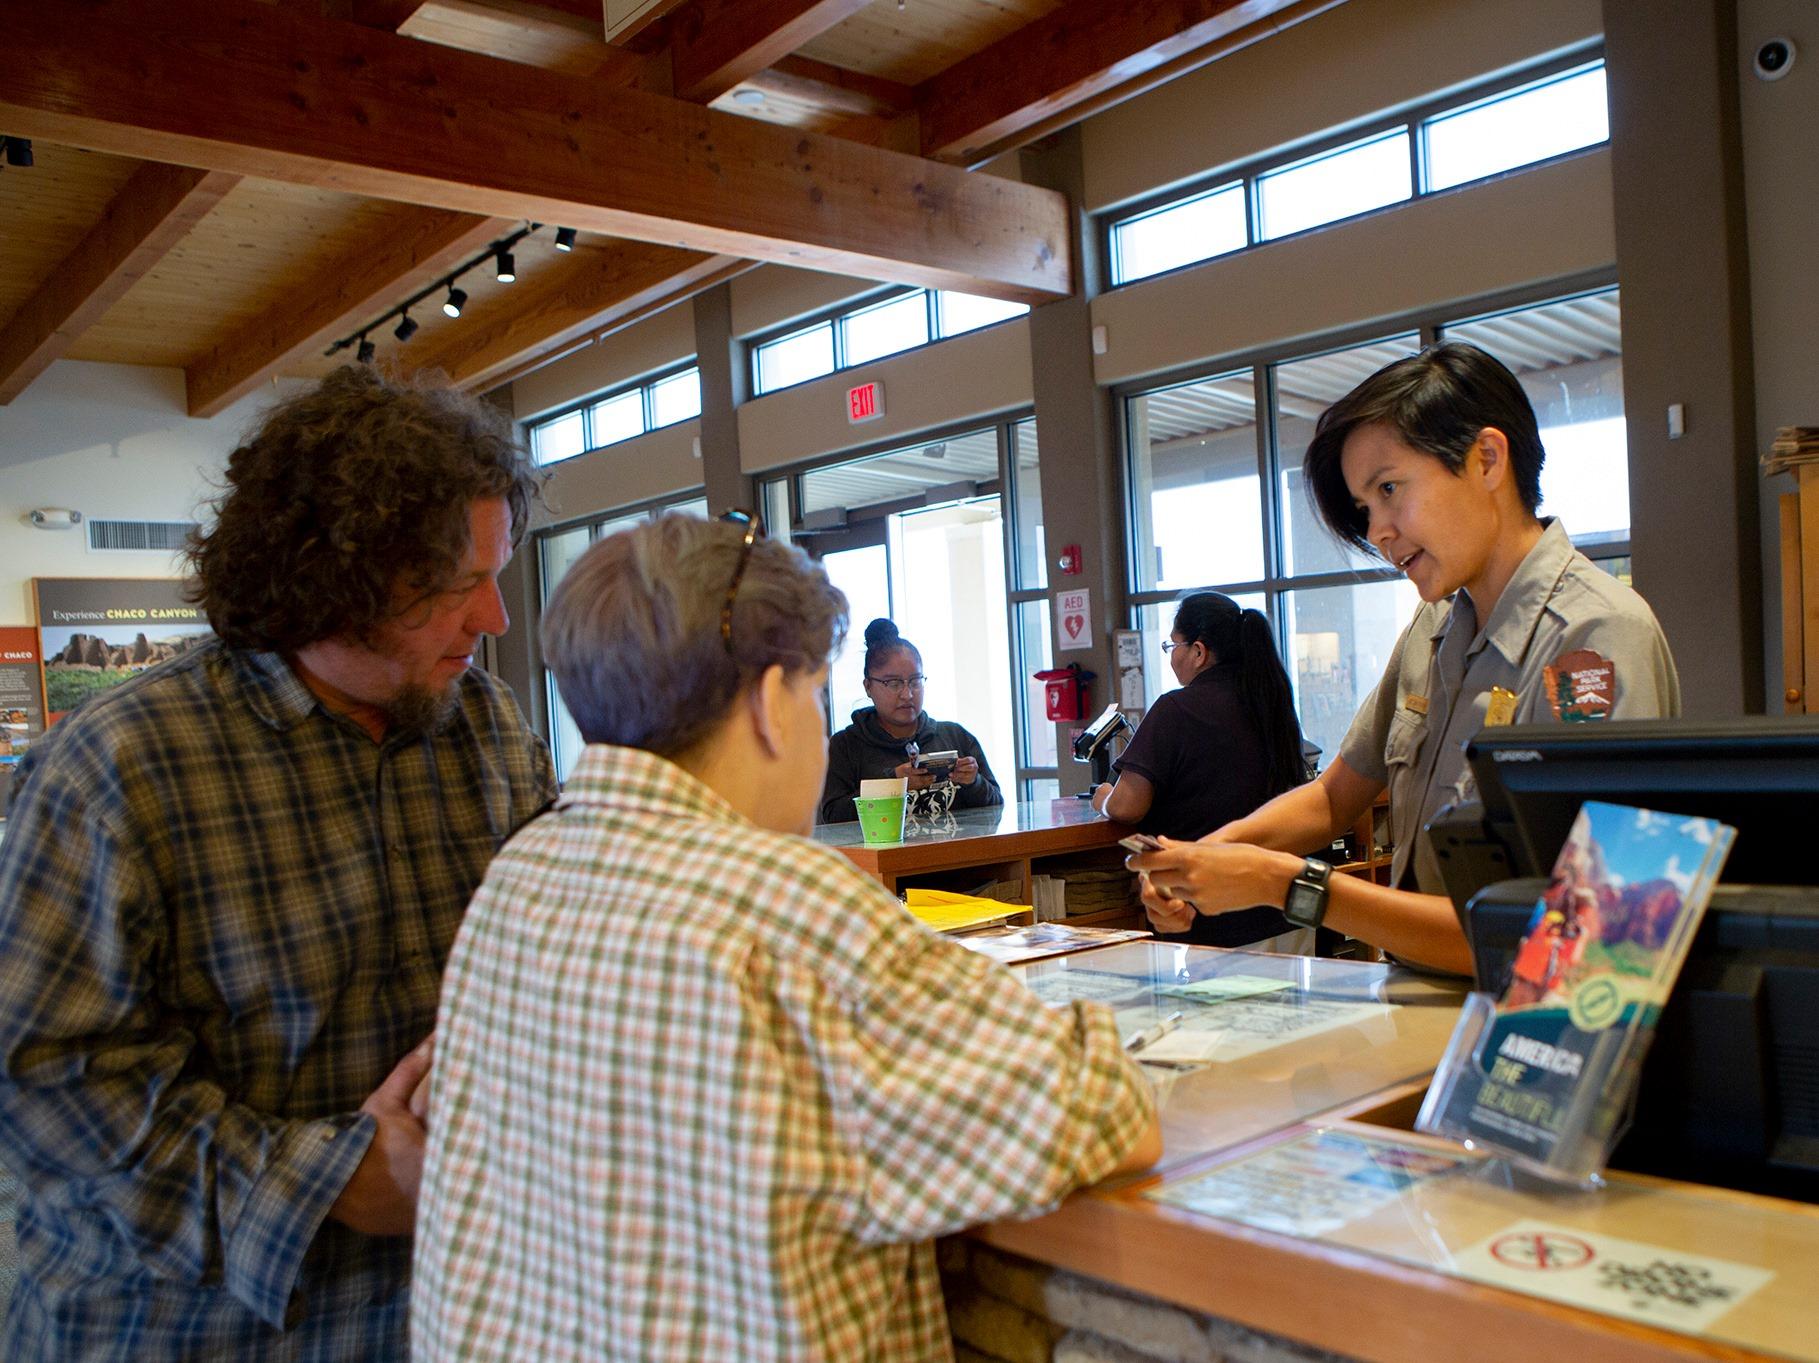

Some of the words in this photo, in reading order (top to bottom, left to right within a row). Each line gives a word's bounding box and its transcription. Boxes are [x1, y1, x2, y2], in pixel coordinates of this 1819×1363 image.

[851, 384, 874, 419] EXIT
[1064, 596, 1083, 609] AED
[53, 609, 105, 622] Experience
[106, 608, 146, 619] CHACO
[151, 608, 197, 619] CANYON
[4, 651, 33, 660] CHACO
[1571, 668, 1611, 679] NATIONAL
[1580, 676, 1601, 684] PARK
[1576, 681, 1608, 693] SERVICE
[1498, 1032, 1584, 1078] AMERICA
[1489, 1056, 1527, 1087] THE
